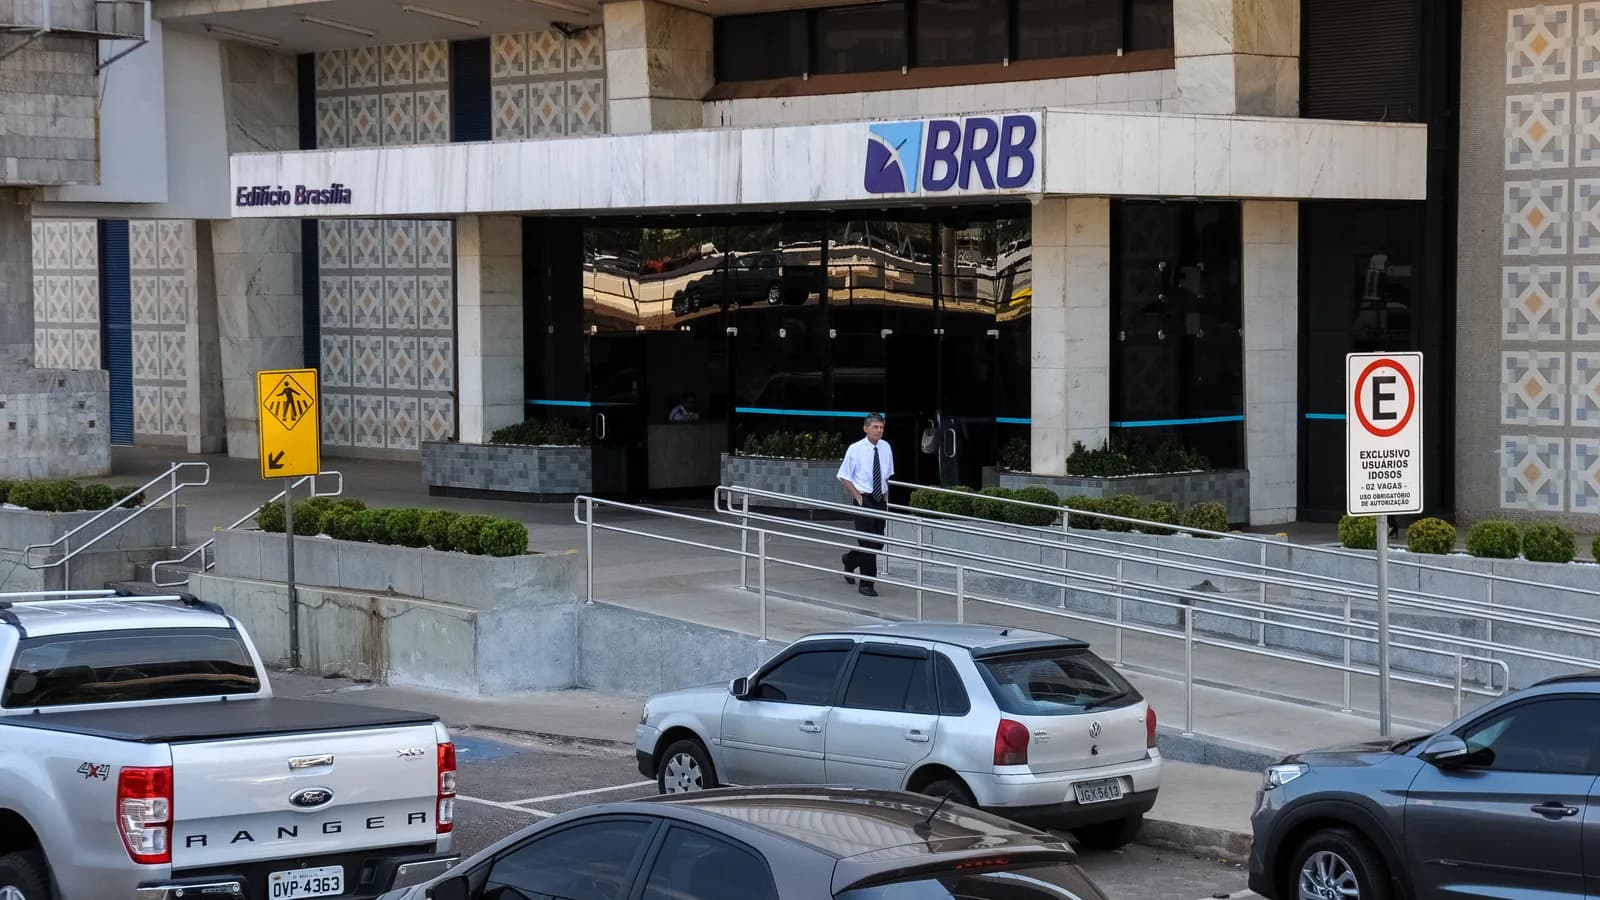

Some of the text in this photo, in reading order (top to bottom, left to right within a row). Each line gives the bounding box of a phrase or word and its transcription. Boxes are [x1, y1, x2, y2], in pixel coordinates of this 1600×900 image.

[922, 115, 1037, 192] BRB
[236, 183, 352, 206] Edifício Brasília
[1372, 376, 1397, 420] E
[1360, 449, 1410, 459] EXCLUSIVO
[1361, 459, 1408, 469] USUÁRIOS
[1368, 470, 1402, 480] IDOSOS
[1377, 482, 1402, 490] VAGAS
[184, 812, 426, 848] RANGER
[273, 876, 340, 897] OVP-4363
